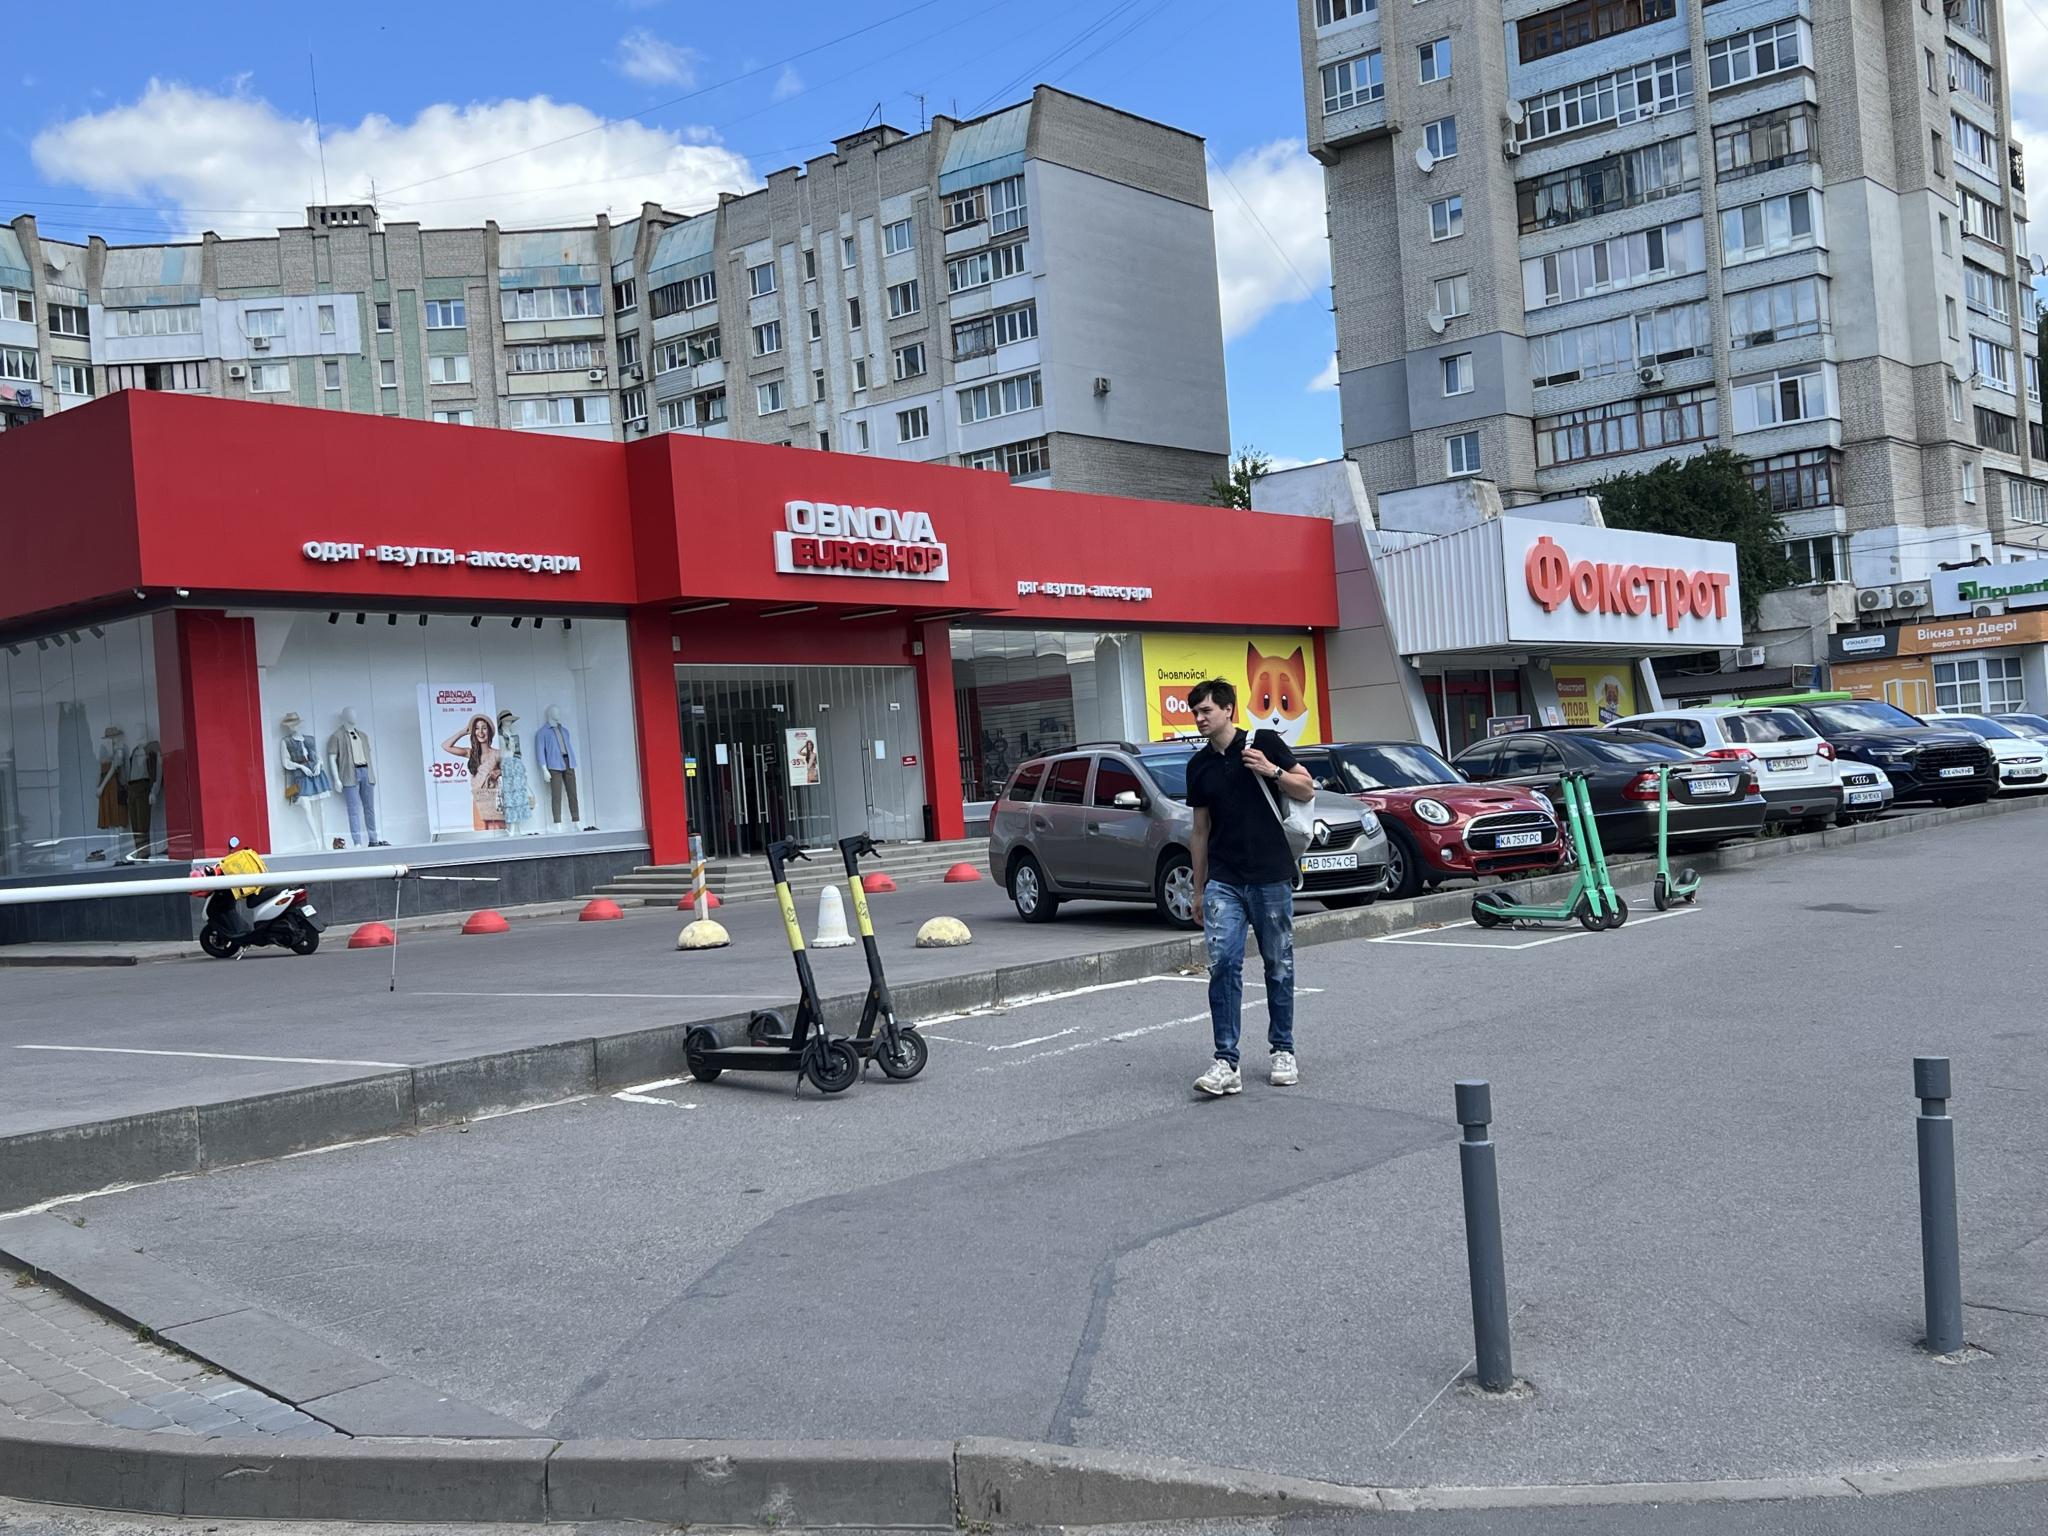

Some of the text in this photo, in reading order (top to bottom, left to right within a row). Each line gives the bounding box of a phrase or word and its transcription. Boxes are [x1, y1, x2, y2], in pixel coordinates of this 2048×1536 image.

[785, 500, 938, 544] OBNOVA
[791, 538, 943, 573] EUROSHOP
[1017, 581, 1039, 595] дяг
[1525, 536, 1730, 630] Фокстрот
[1917, 619, 2017, 641] Вікна та Двері
[1158, 668, 1208, 680] Оновлюйся!
[428, 762, 468, 778] -35%
[1500, 833, 1540, 846] KA 7537 PC
[1307, 856, 1356, 869] AB 0574 CE
